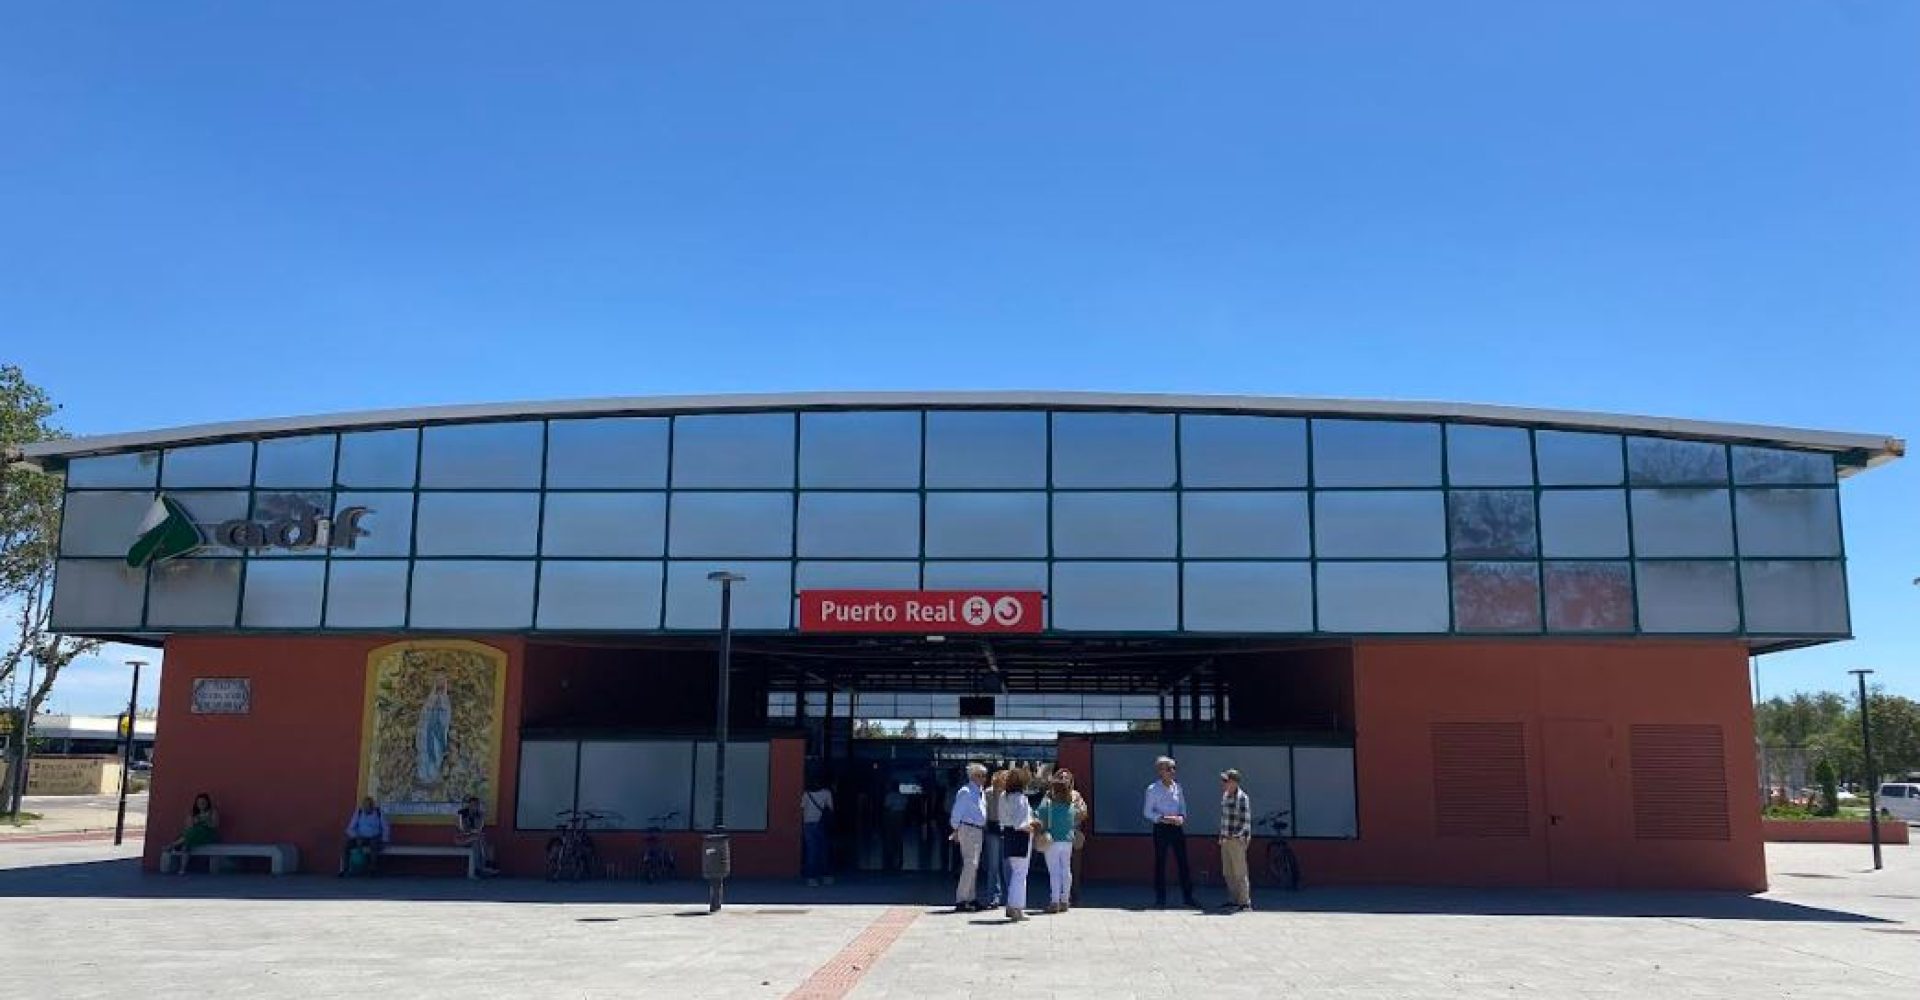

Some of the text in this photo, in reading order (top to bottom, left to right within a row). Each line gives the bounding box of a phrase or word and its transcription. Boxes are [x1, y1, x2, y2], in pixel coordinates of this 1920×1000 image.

[216, 506, 373, 549] adif
[821, 599, 956, 622] Puerto Real
